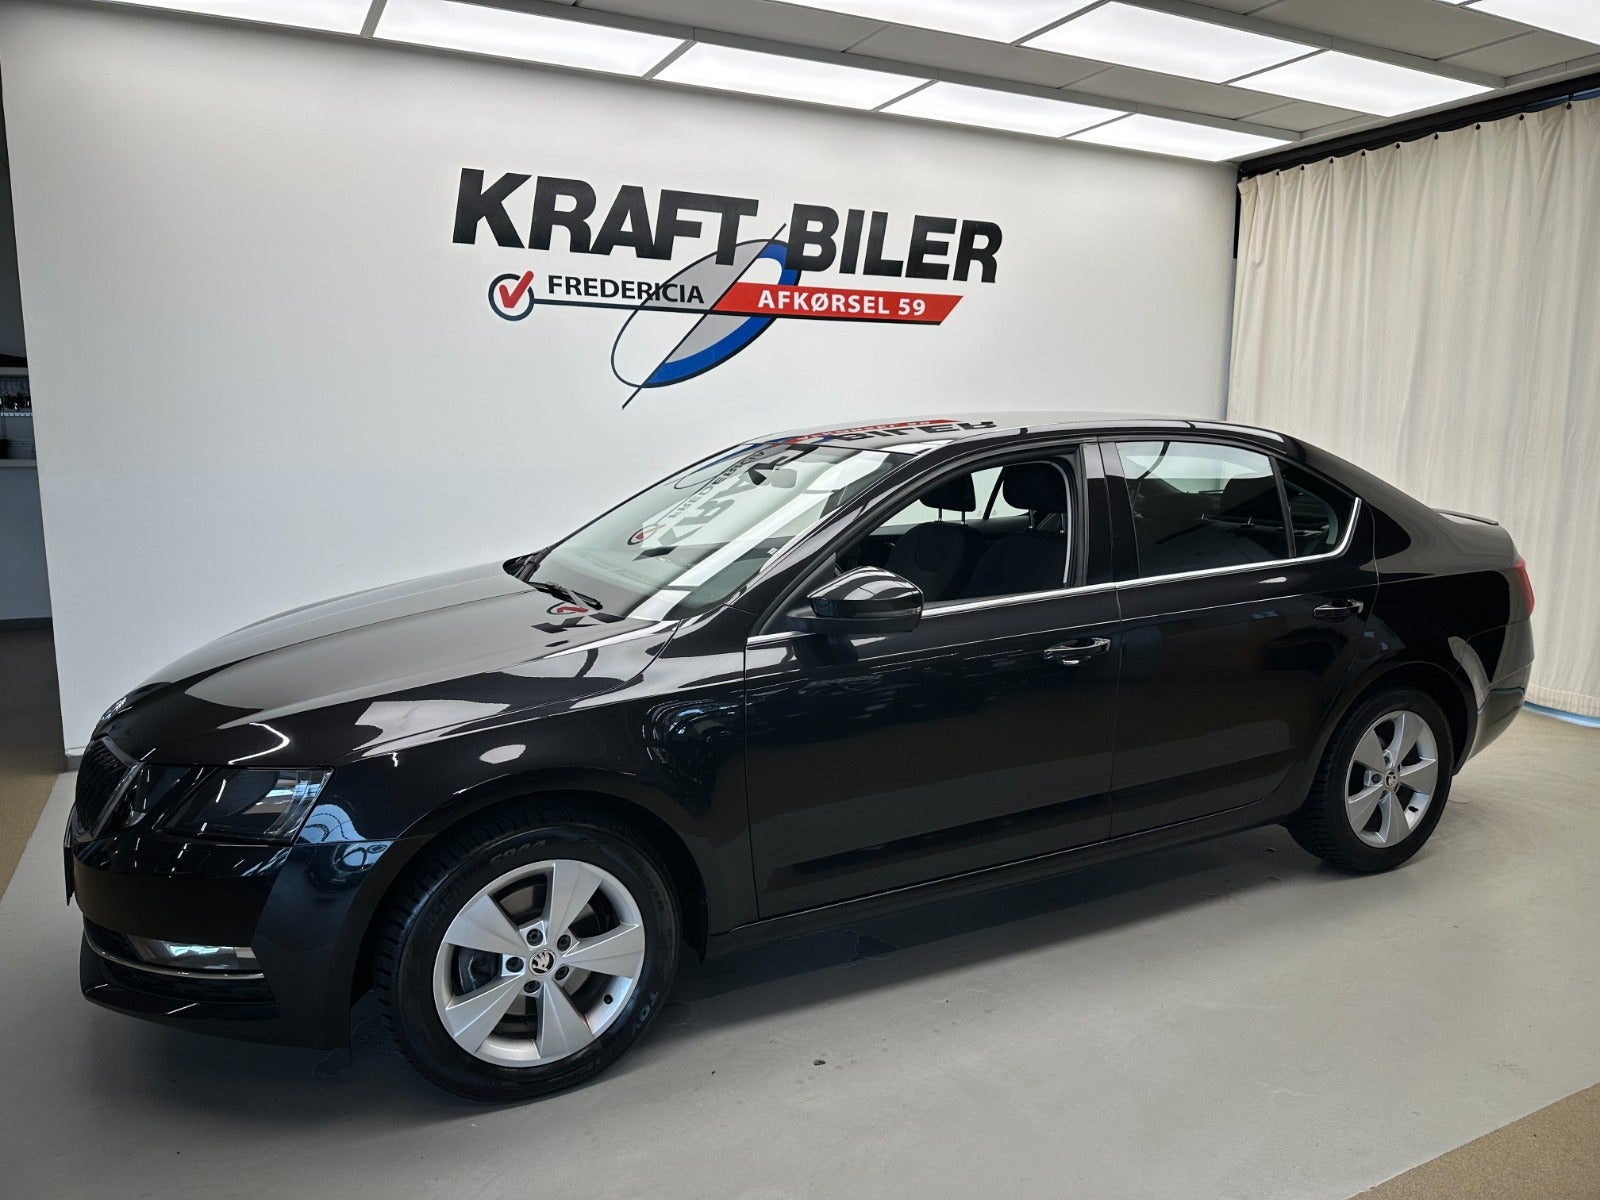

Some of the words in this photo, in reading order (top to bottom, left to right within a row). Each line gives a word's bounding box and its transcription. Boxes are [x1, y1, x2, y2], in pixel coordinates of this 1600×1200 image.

[453, 167, 758, 266] KRAFT
[785, 203, 1004, 284] BILER
[548, 275, 704, 304] FREDERICIA
[757, 289, 890, 315] AFKØRSEL
[898, 298, 927, 317] 59
